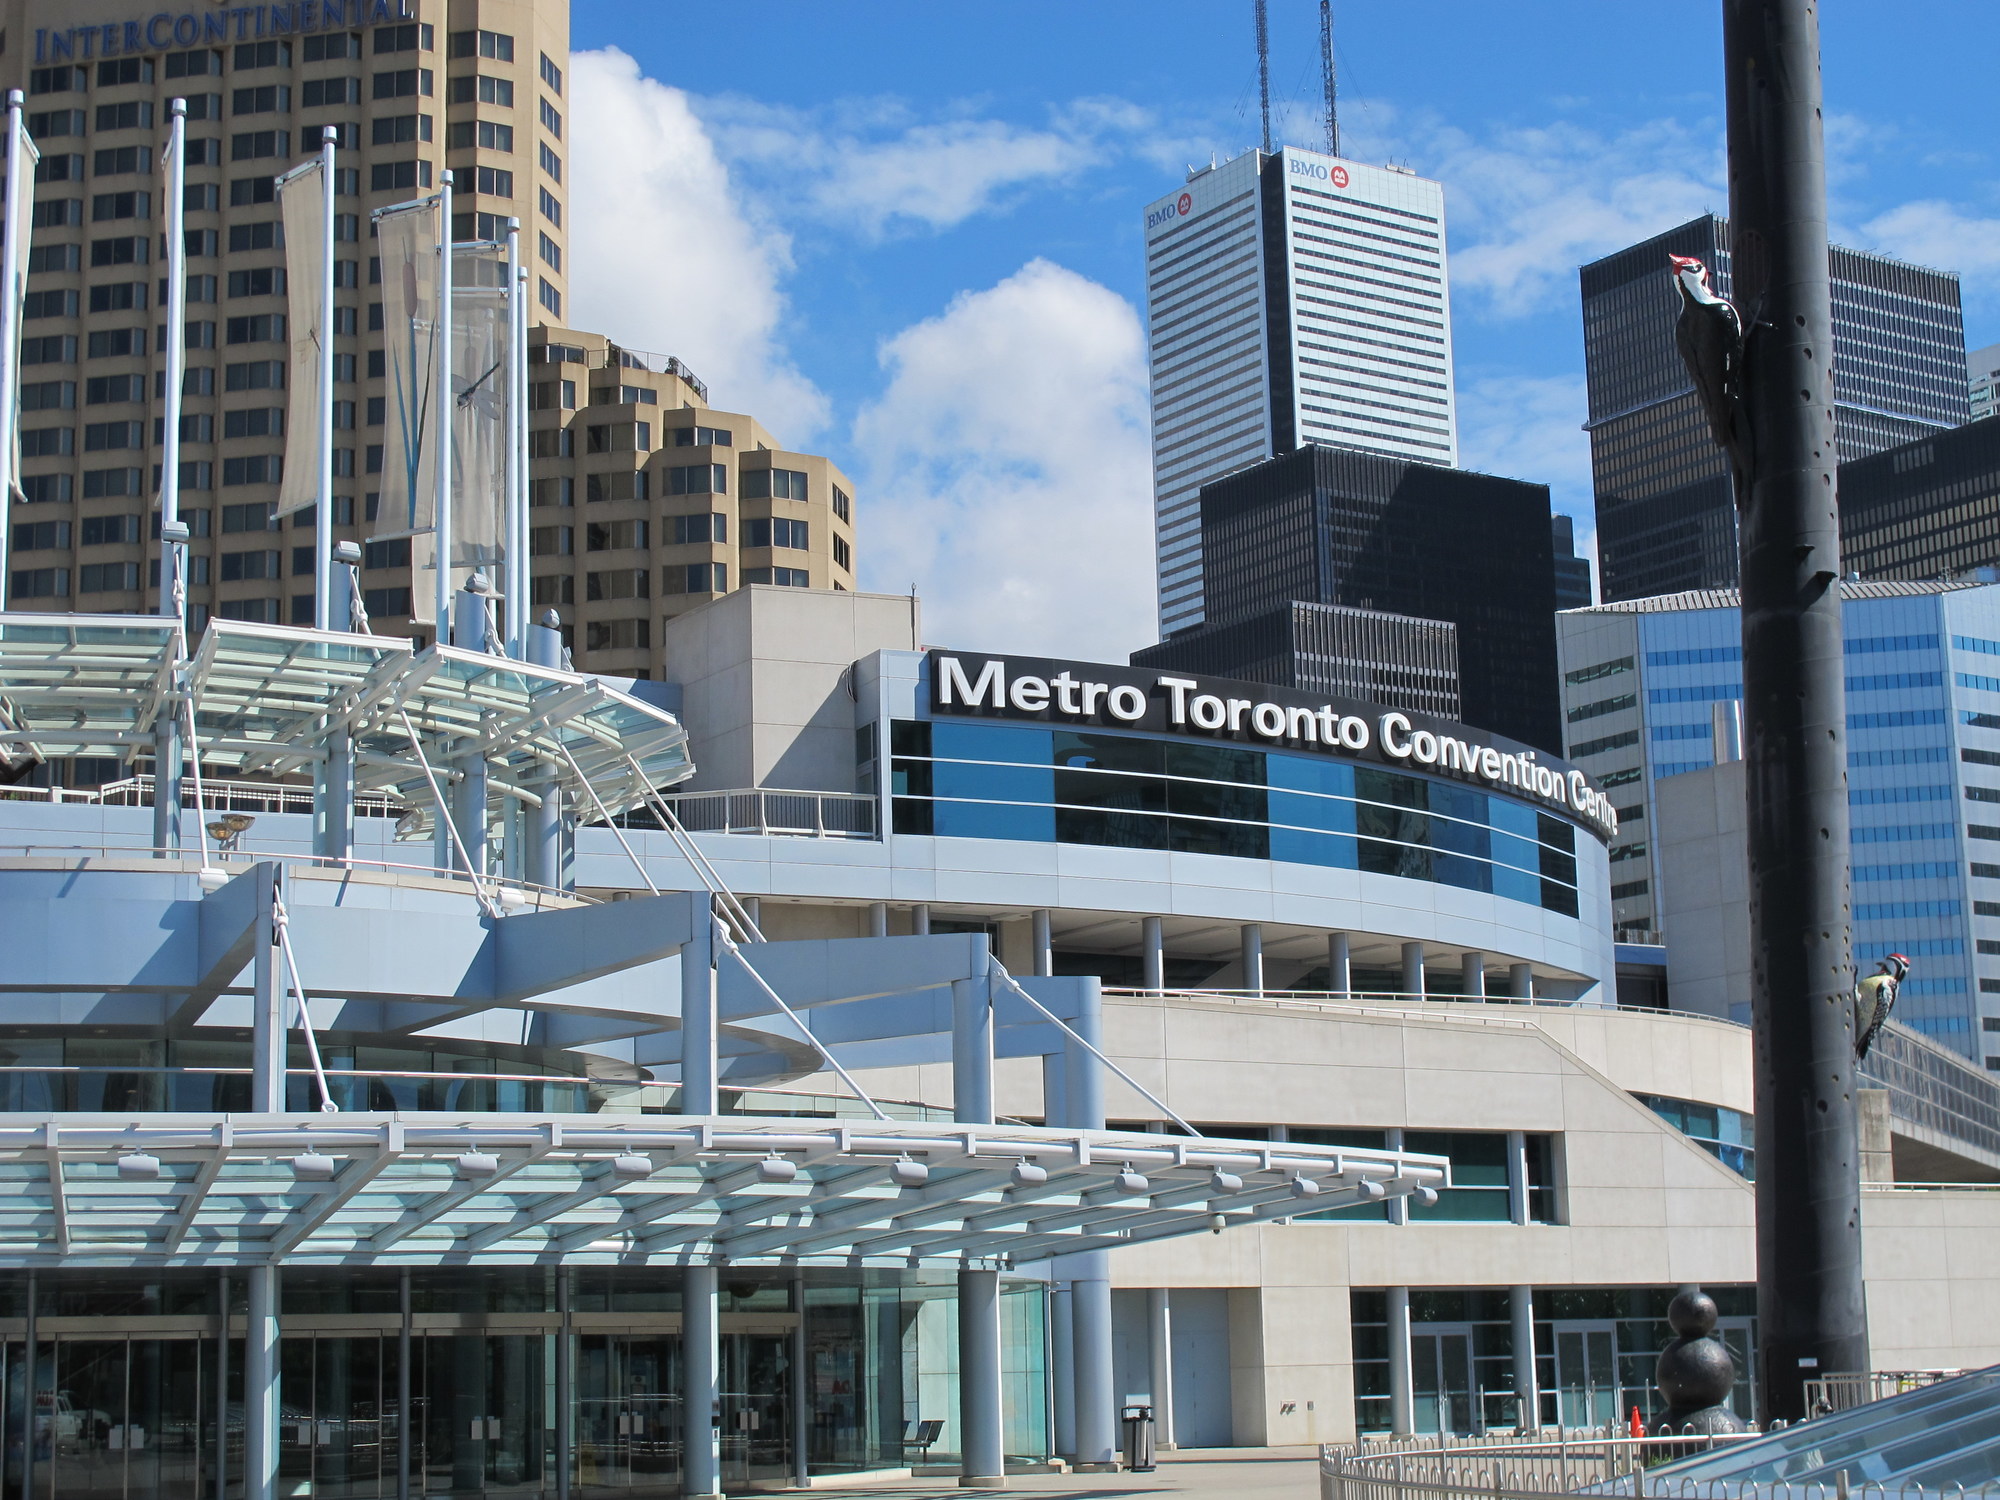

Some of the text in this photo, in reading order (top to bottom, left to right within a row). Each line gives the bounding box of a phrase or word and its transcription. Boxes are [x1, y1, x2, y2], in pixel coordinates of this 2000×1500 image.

[1289, 158, 1328, 181] BMO
[1147, 203, 1176, 230] BMO
[938, 656, 1618, 836] Metro Toronto Convention Centre
